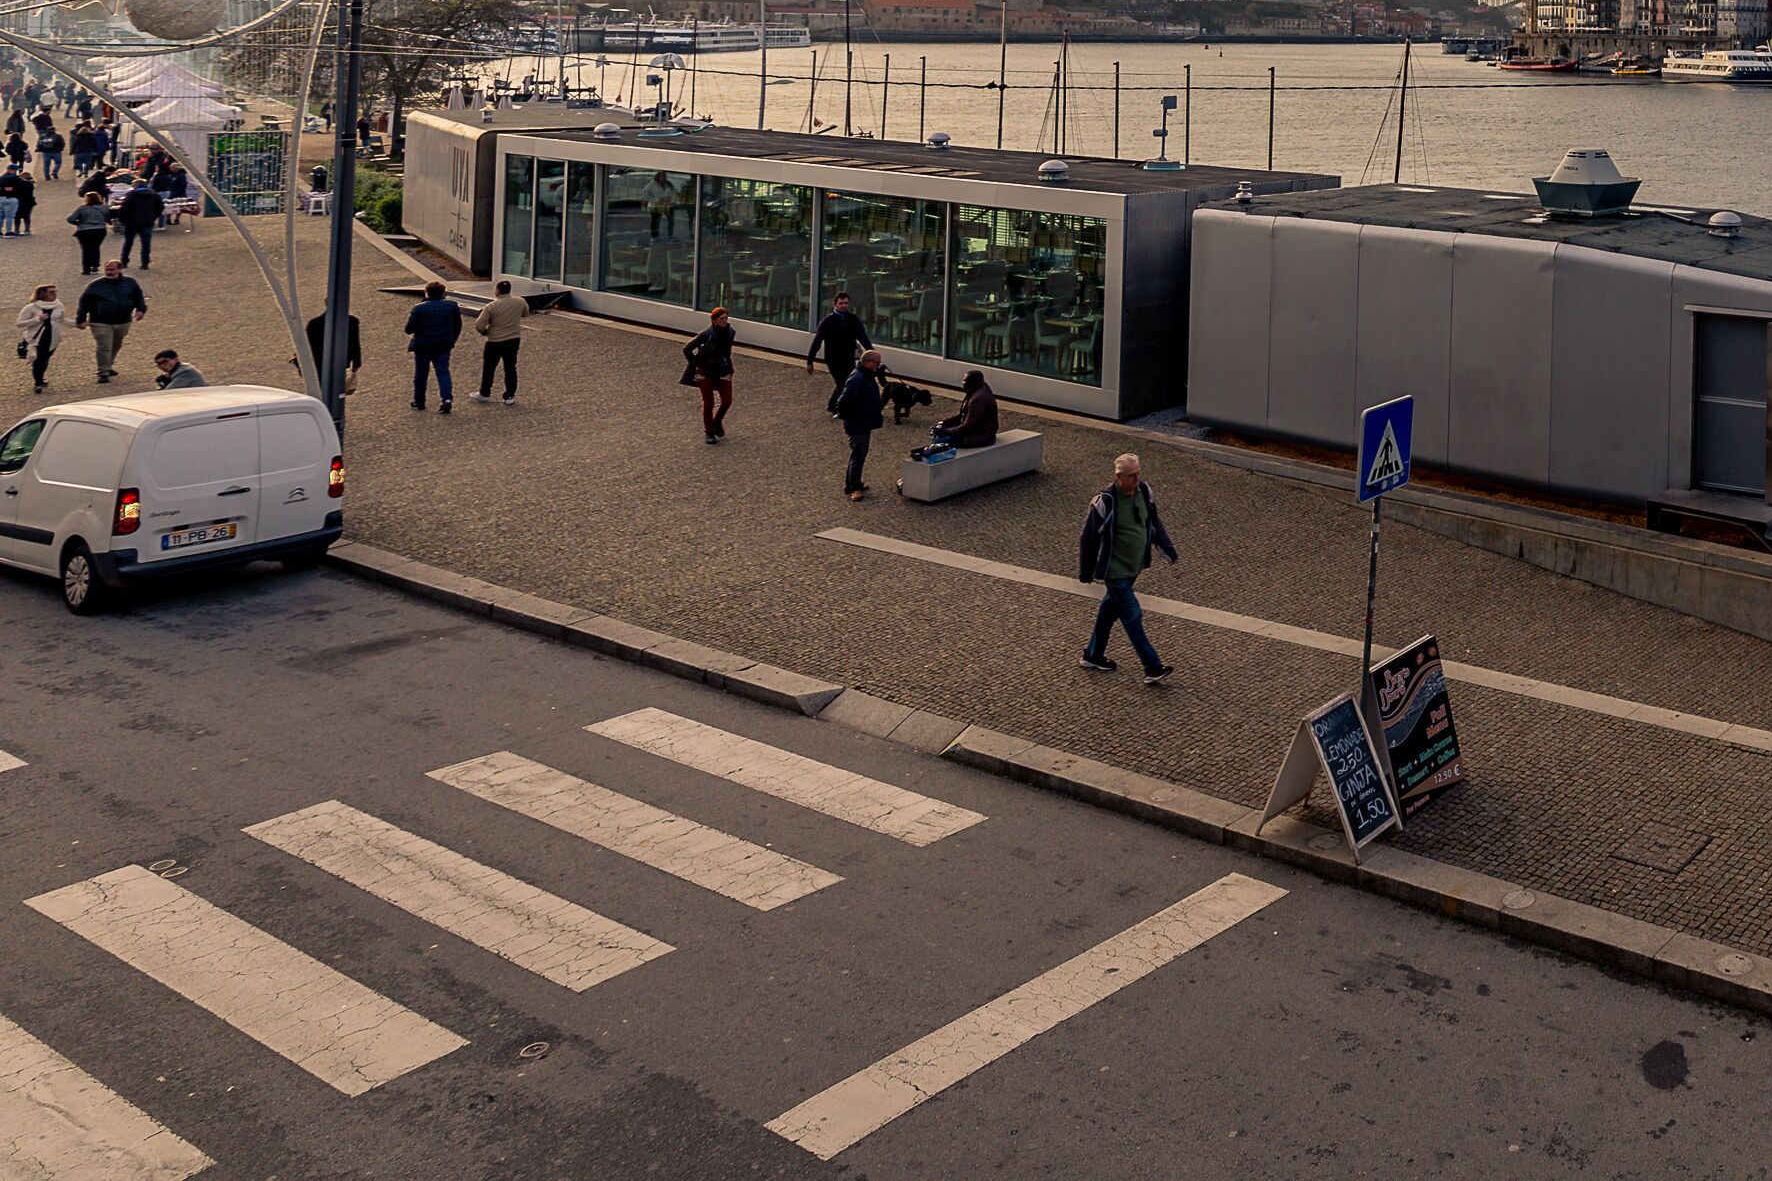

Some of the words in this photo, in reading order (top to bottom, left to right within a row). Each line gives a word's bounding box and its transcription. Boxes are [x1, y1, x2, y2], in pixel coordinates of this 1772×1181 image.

[1430, 704, 1447, 723] Full
[1426, 718, 1449, 739] Menu
[1325, 727, 1366, 762] LEMONADE
[1338, 764, 1377, 802] GINJA
[1433, 770, 1452, 784] 12.50
[1454, 763, 1461, 776] €
